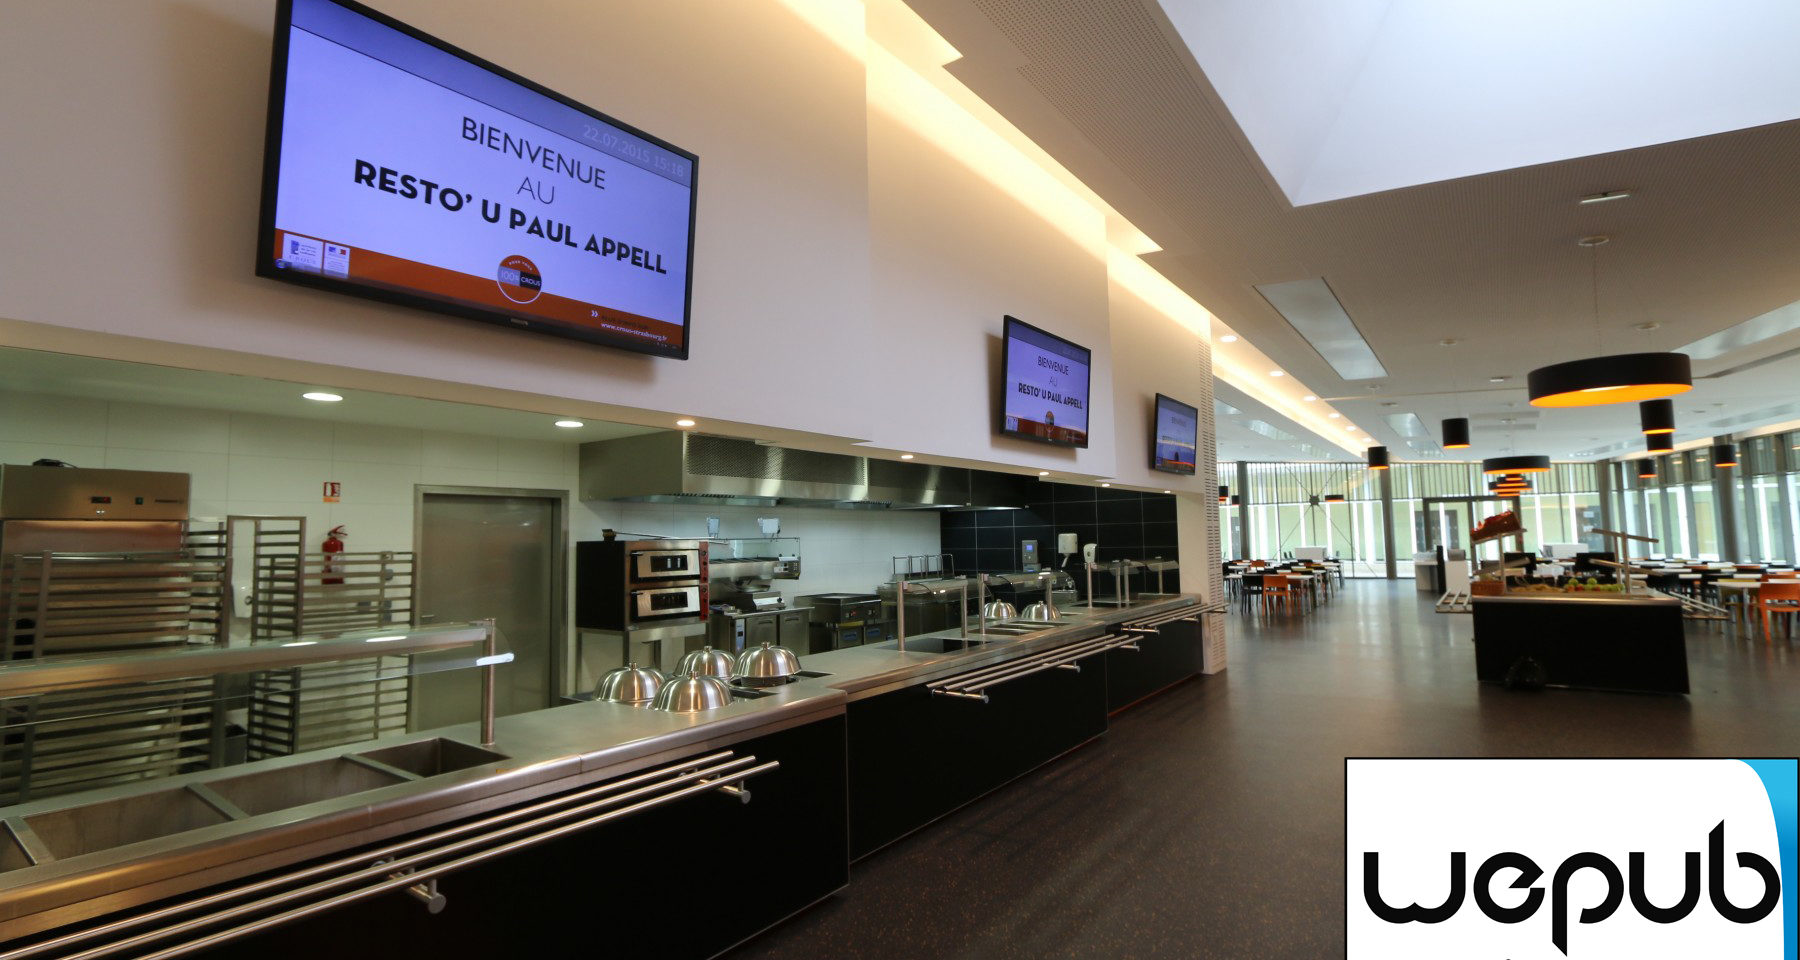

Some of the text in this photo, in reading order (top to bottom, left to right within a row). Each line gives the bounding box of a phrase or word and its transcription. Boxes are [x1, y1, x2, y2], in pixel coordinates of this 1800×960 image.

[461, 116, 606, 190] BIENVENUE
[583, 124, 684, 177] 22.07.2015 15:18
[516, 176, 555, 204] AU
[481, 199, 501, 223] U
[509, 207, 578, 248] PAUL
[584, 233, 667, 274] APPELL
[520, 276, 541, 287] CROUS
[1037, 355, 1070, 376] BIENVENUE
[1048, 376, 1058, 387] AU
[1041, 389, 1047, 400] U
[1047, 390, 1063, 404] PAUL
[1063, 396, 1083, 409] APPELL
